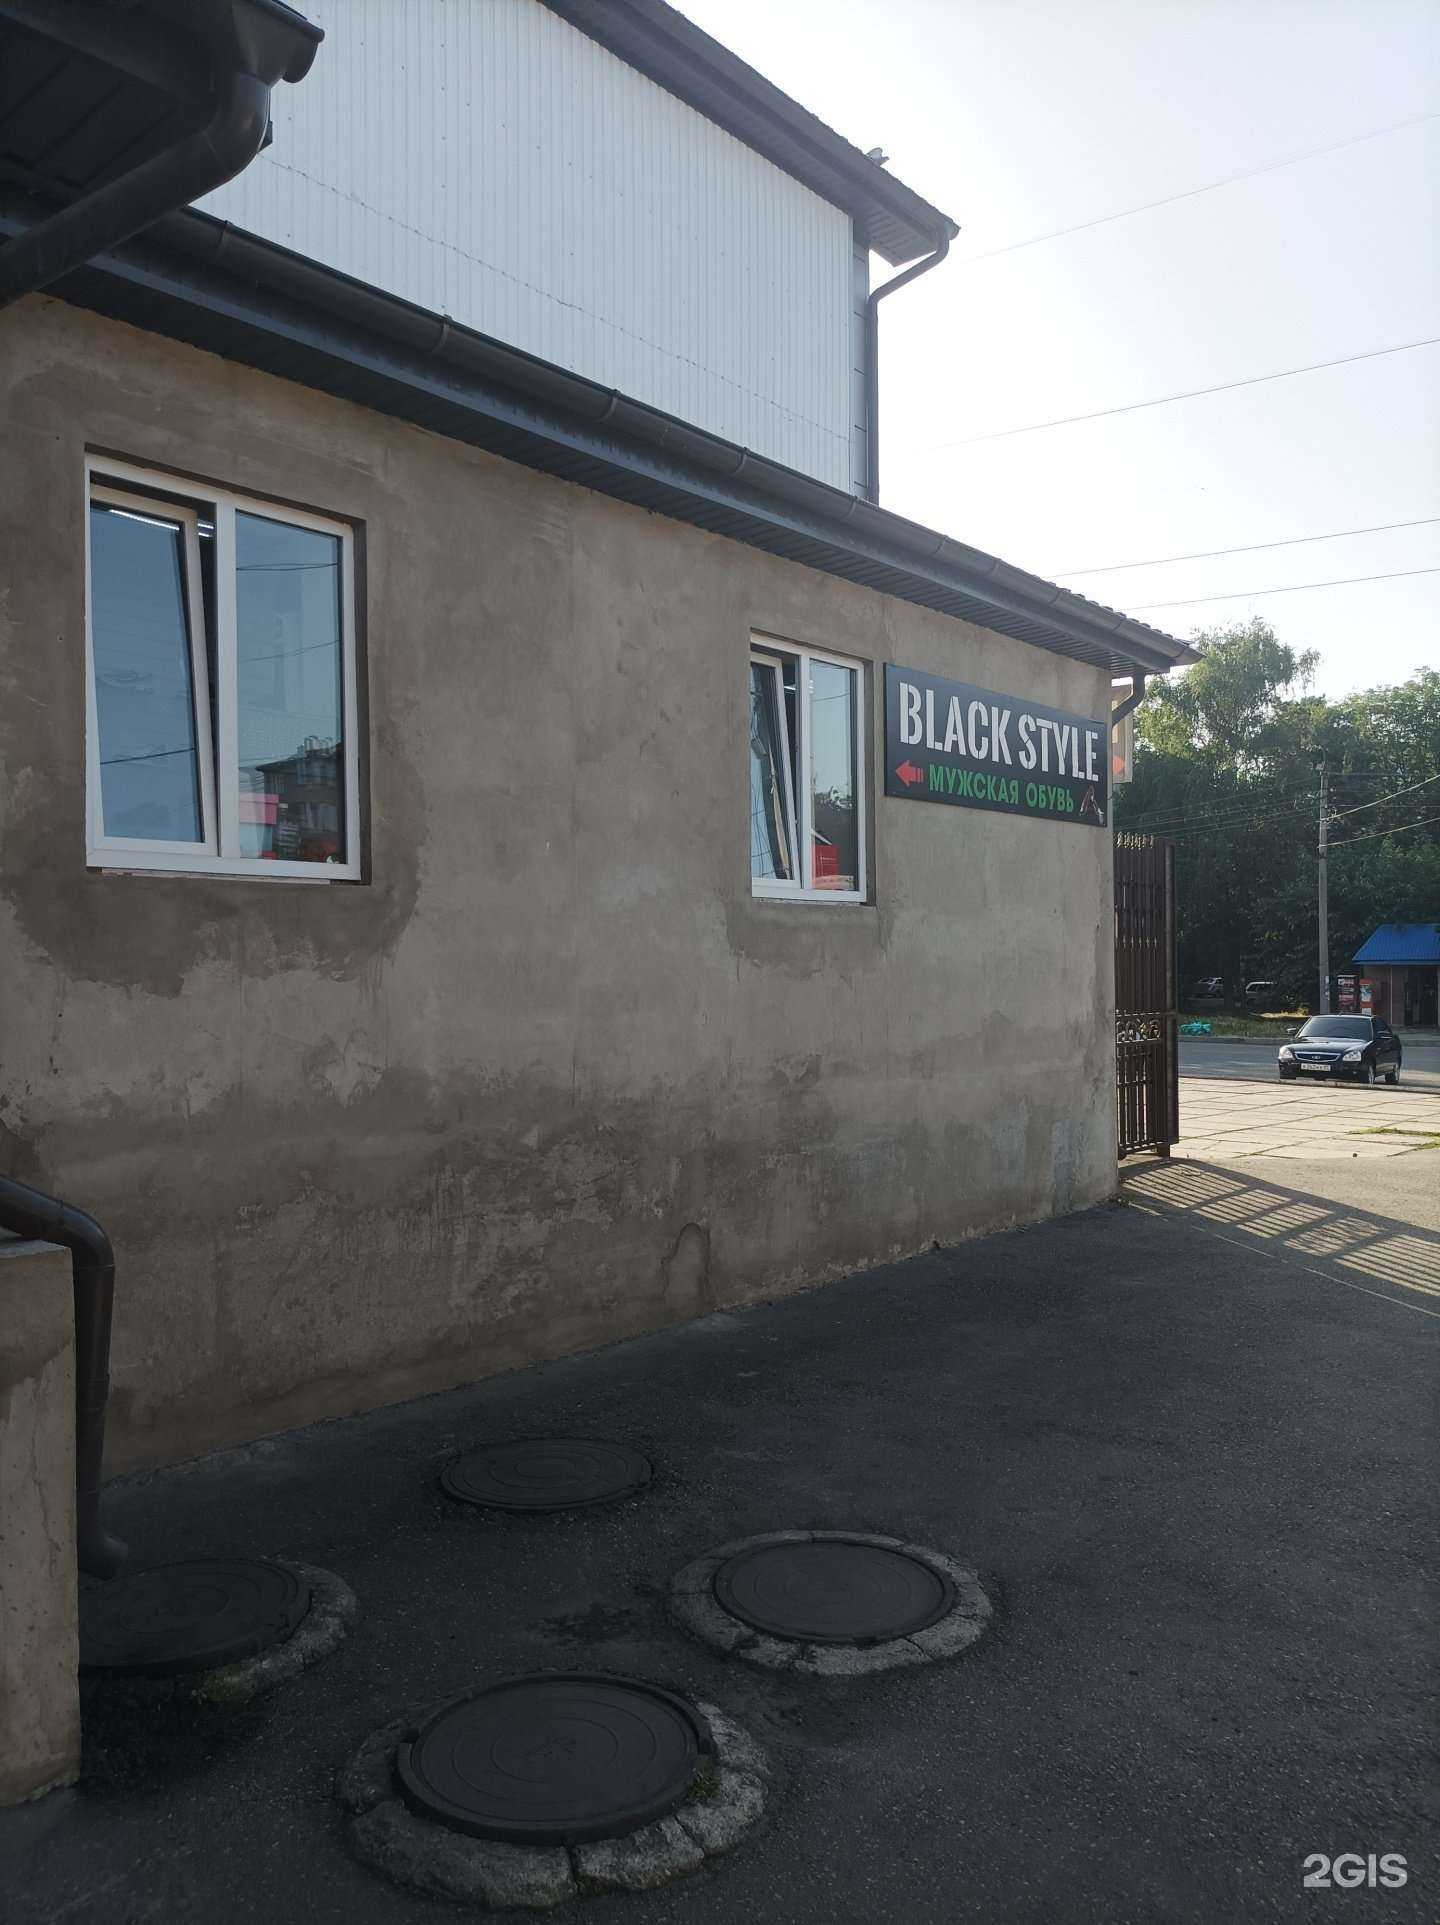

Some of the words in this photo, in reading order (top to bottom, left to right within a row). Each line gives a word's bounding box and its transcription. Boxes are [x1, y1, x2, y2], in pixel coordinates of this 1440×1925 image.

[899, 682, 1012, 765] BLACK
[1018, 714, 1098, 781] STYLE
[929, 764, 1018, 804] МУЖСКАЯ
[1026, 783, 1074, 813] ОБУВЬ
